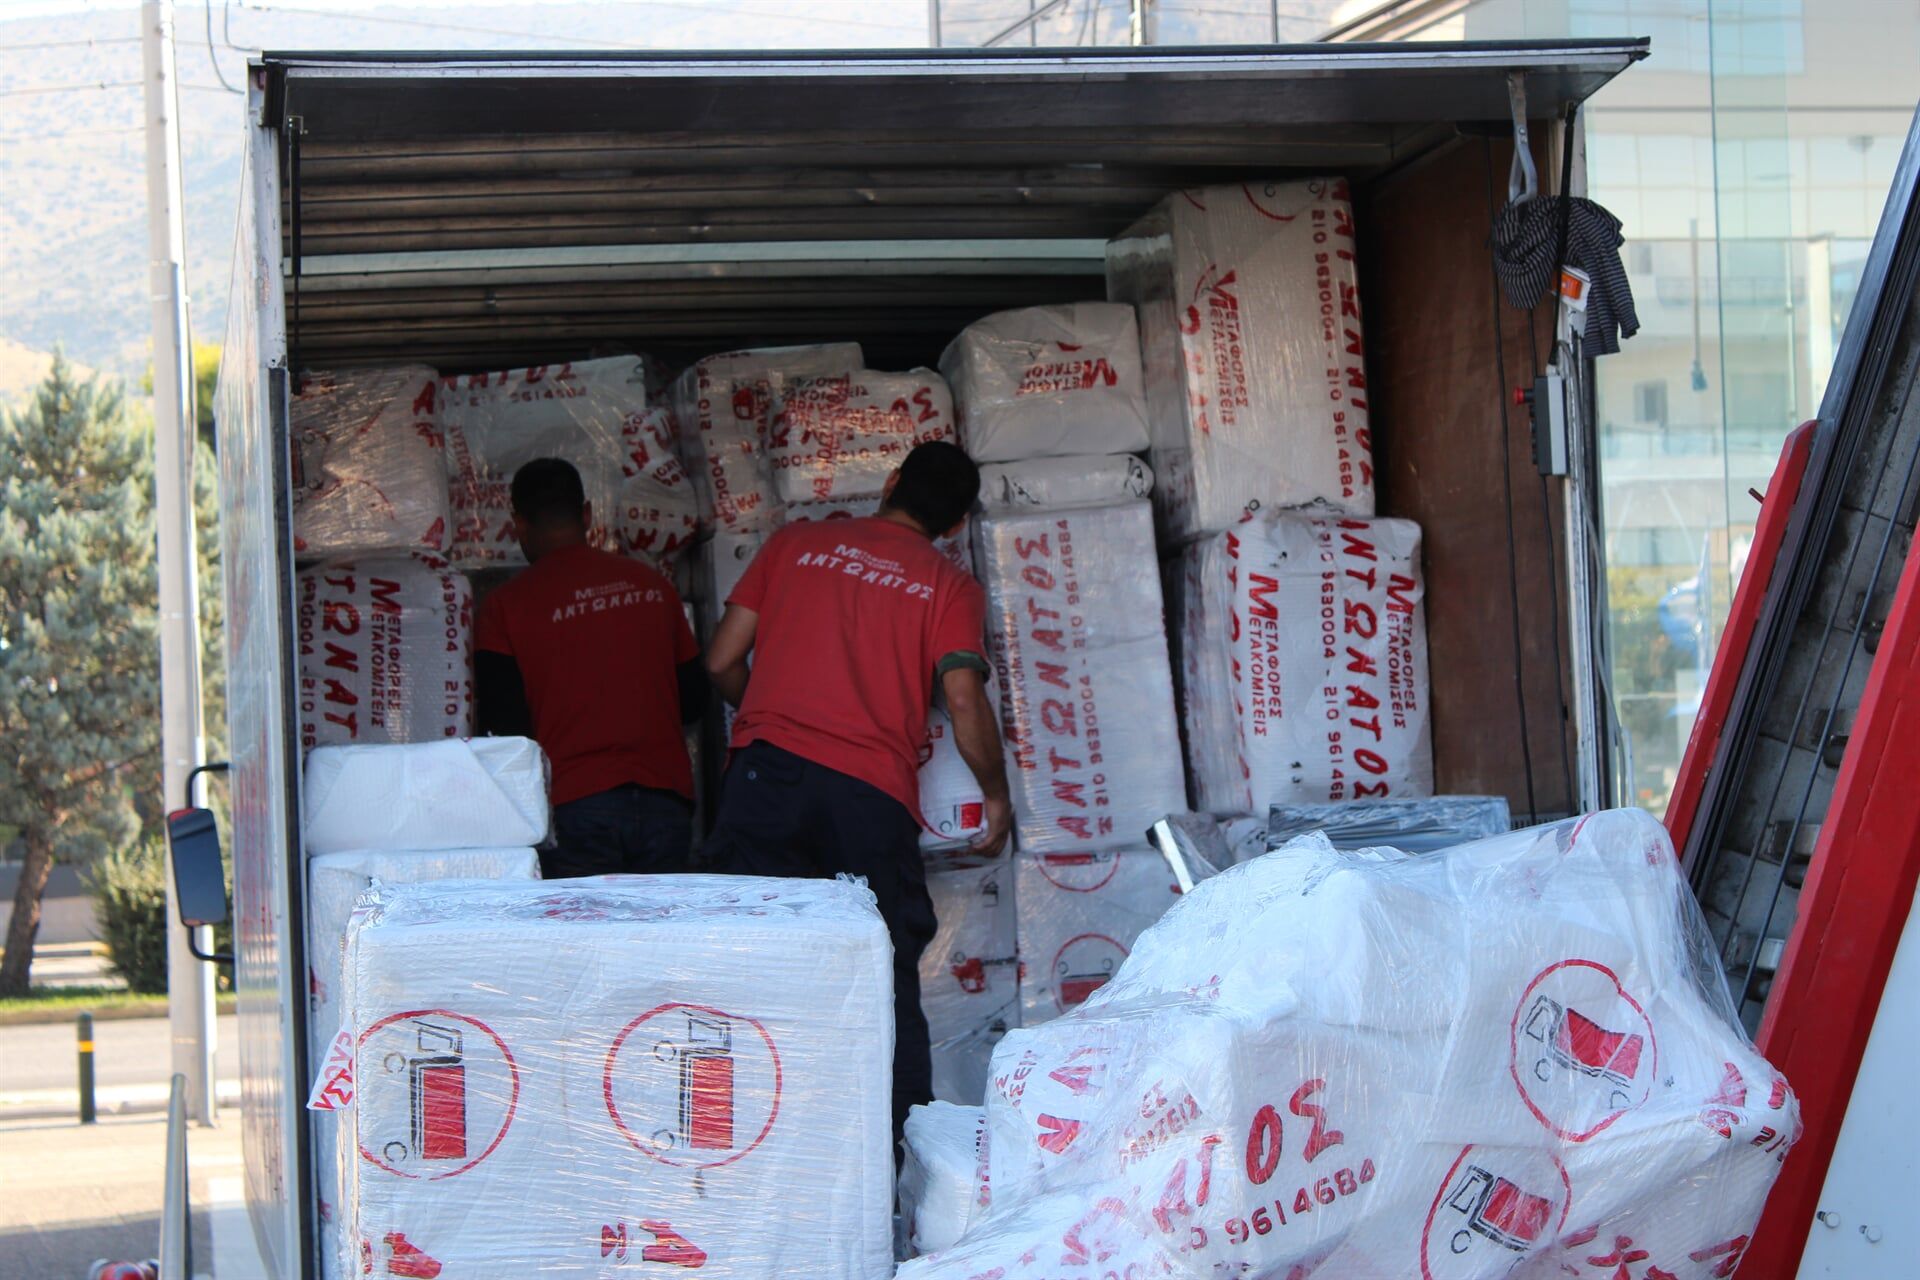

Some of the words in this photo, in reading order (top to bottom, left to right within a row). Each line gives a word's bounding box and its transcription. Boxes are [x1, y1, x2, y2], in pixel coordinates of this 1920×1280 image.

[1311, 209, 1328, 244] 210
[1314, 253, 1337, 342] 9630004
[1326, 368, 1342, 401] 210
[1332, 411, 1355, 498] 9614684
[797, 551, 934, 600] ΑΝΤΩΝΑΤΟΣ
[1055, 519, 1080, 606] 9614684
[551, 588, 665, 624] ΑΝΤΩΝΑΤΟΣ
[1069, 615, 1087, 649] 210
[1320, 571, 1336, 659] 9630004
[322, 574, 361, 740] ΤΩΝΑΤ
[1014, 532, 1093, 840] ΑΝΤΩΝΑΤΟΣ
[1079, 674, 1103, 765] 9630004
[1323, 686, 1340, 721] 210
[1092, 772, 1110, 806] 210
[1327, 731, 1345, 801] 961468
[1224, 1158, 1377, 1245] 9614684
